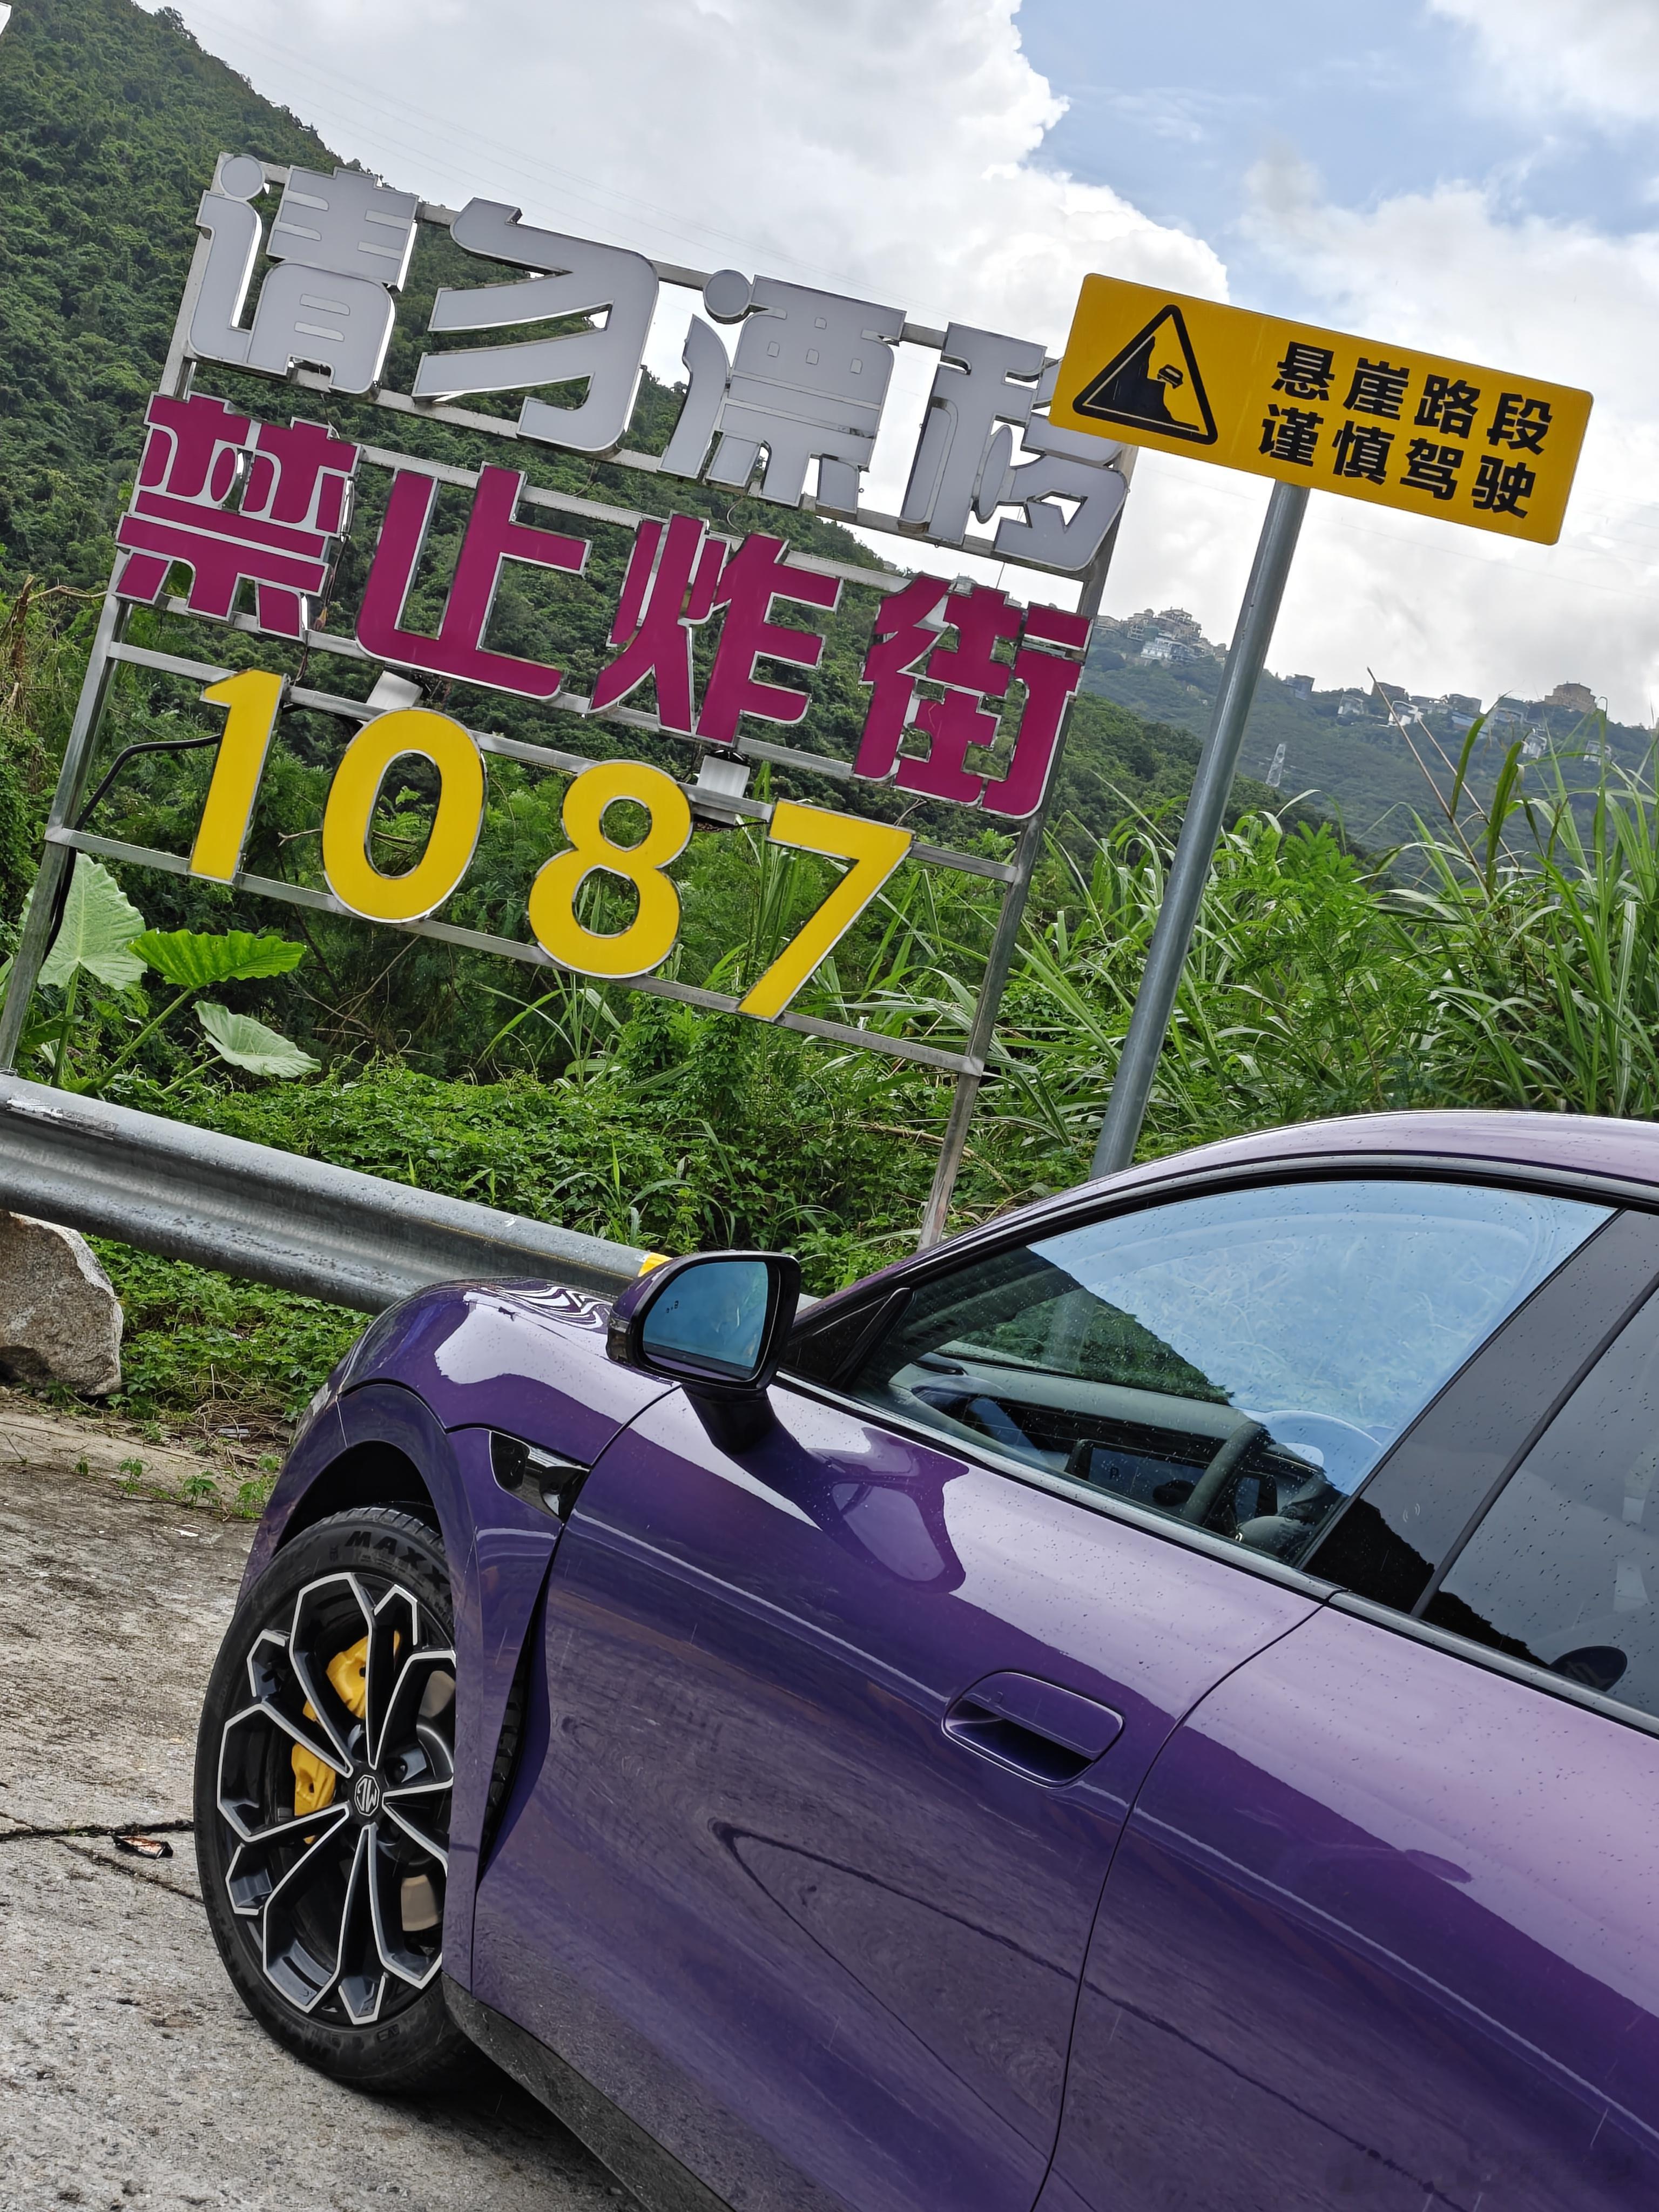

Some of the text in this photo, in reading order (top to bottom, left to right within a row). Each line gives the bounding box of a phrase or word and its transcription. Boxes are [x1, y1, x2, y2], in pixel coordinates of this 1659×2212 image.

[188, 153, 1129, 571] 请勿漂移
[1257, 403, 1537, 520] 谨慎驾驶
[1270, 340, 1553, 456] 悬崖路段
[113, 391, 1092, 819] 禁止炸街
[188, 668, 914, 1021] 1087
[356, 1777, 377, 1812] MG
